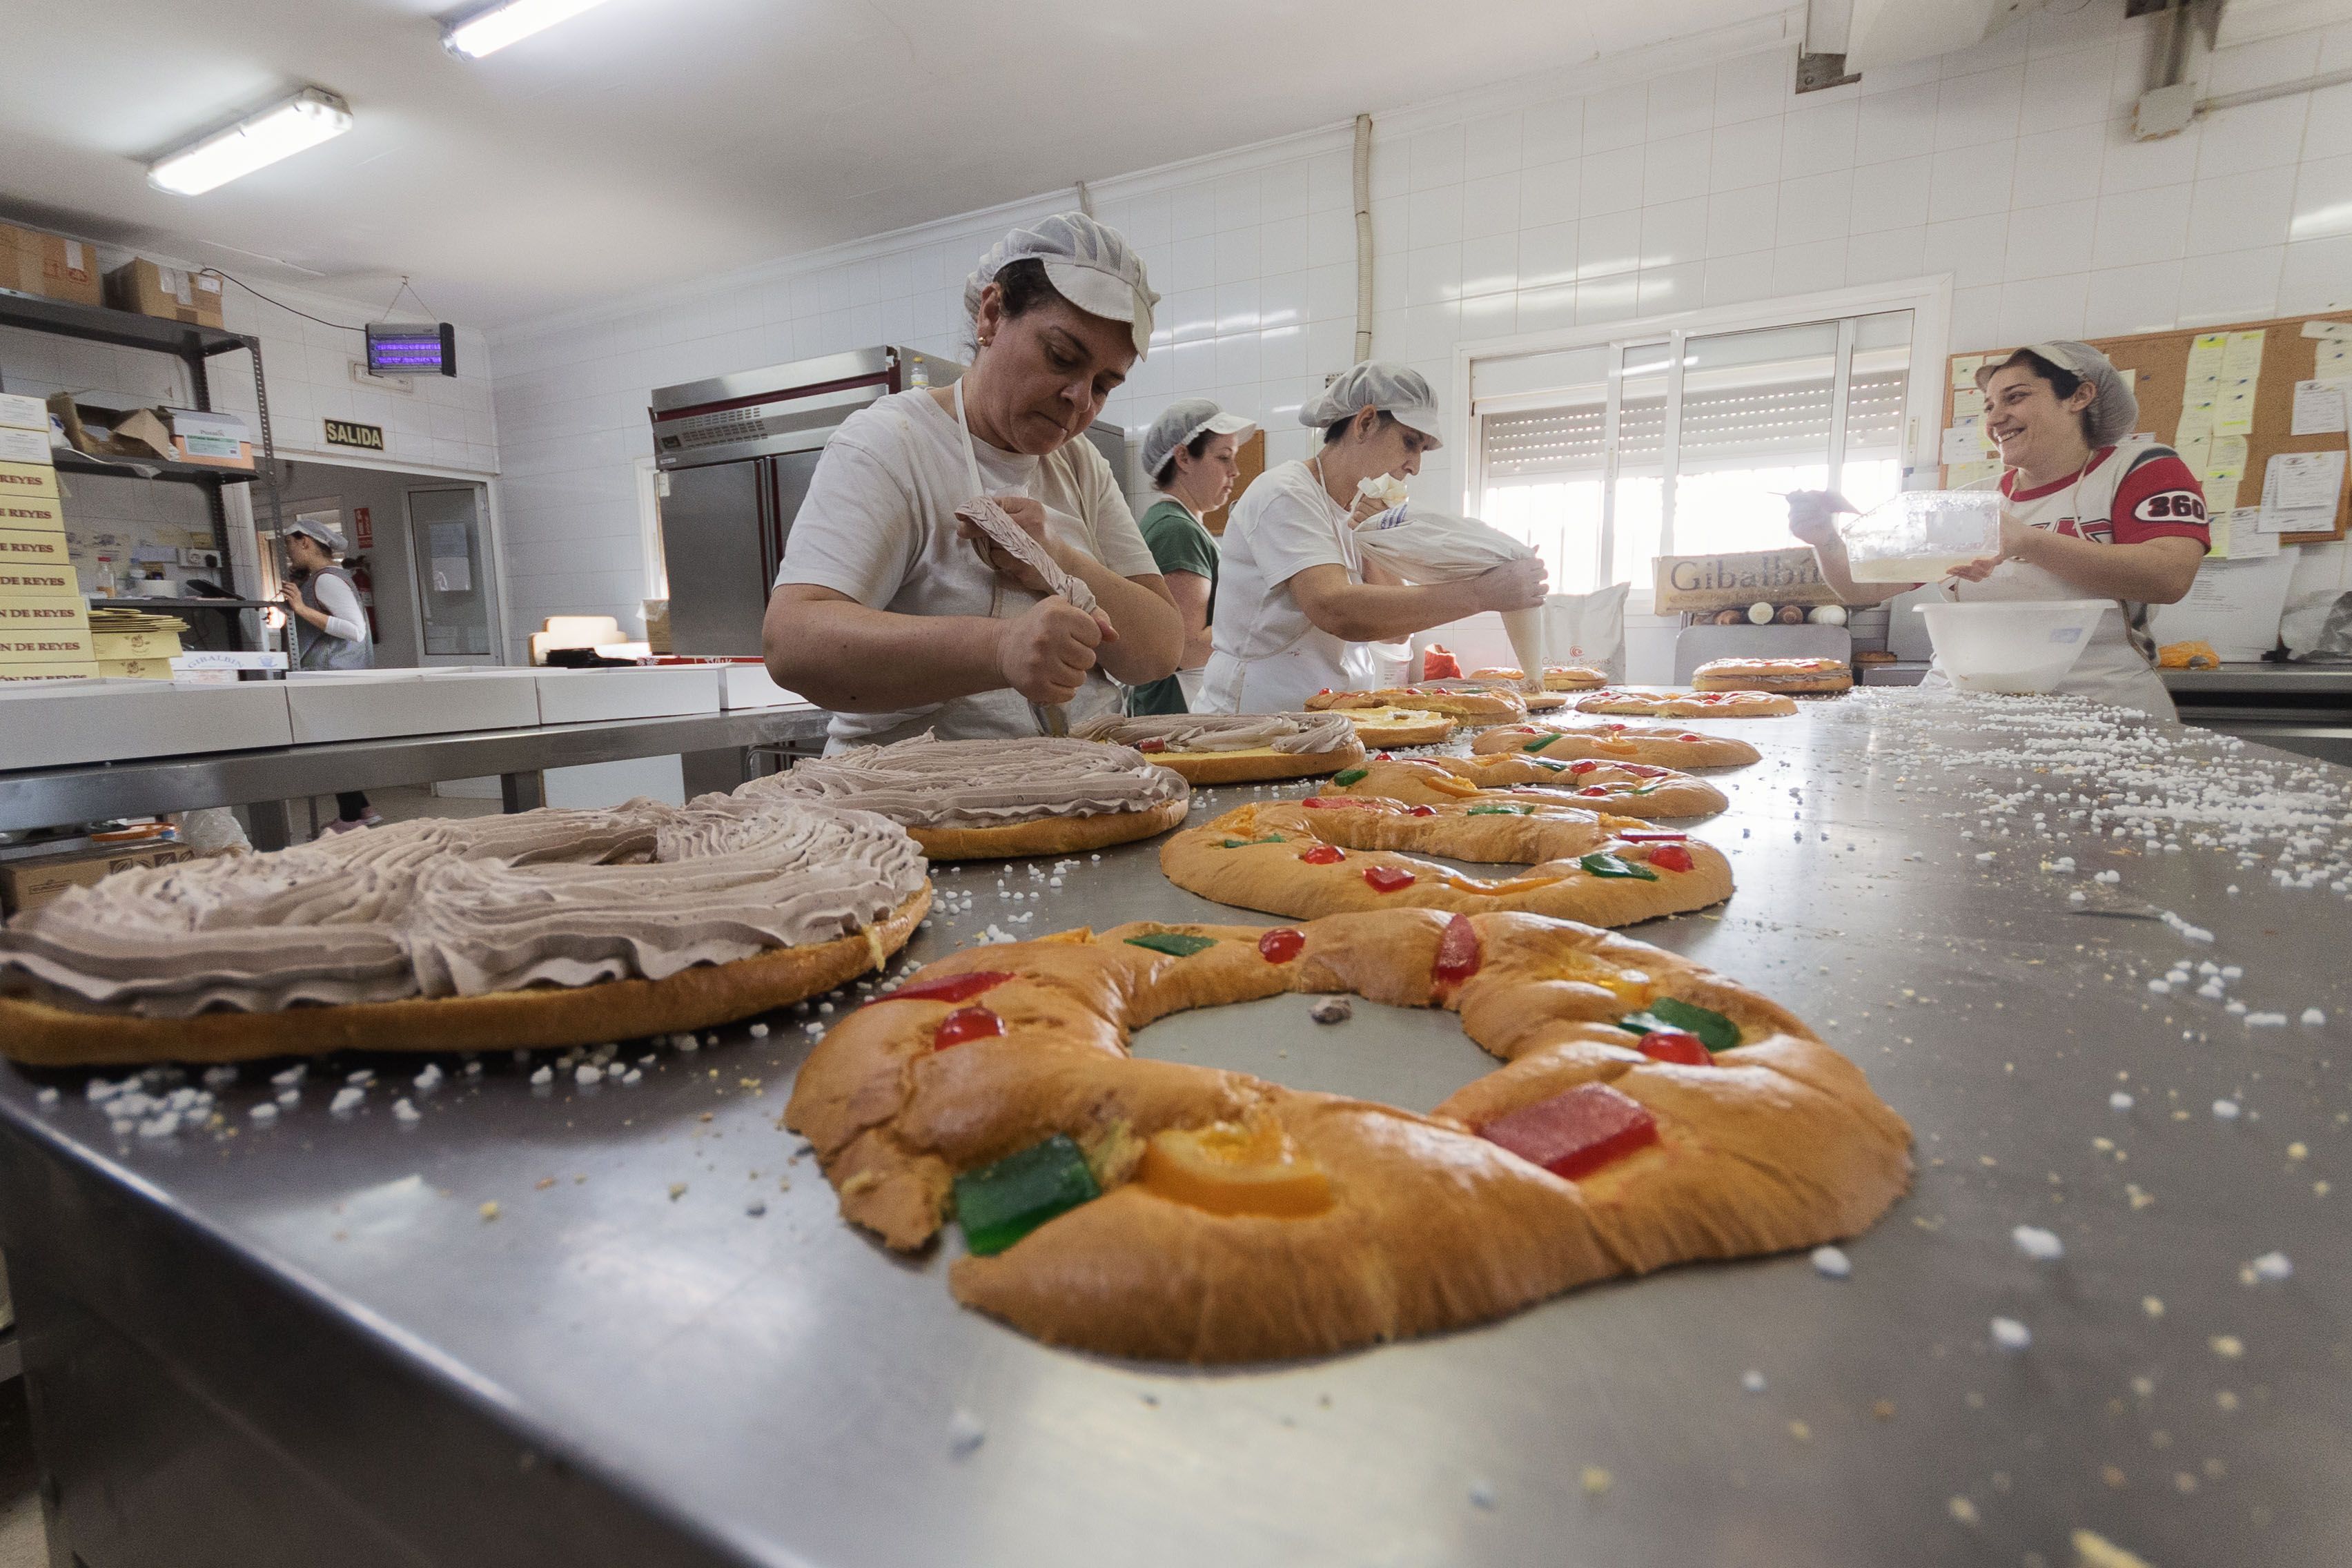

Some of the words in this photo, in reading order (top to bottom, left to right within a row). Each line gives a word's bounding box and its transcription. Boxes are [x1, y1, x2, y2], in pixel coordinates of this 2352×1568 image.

[327, 422, 382, 447] SALIDA
[0, 475, 43, 485] REYES
[2147, 495, 2205, 520] 360
[9, 509, 52, 519] REYES
[10, 543, 55, 553] REYES
[0, 576, 20, 585] DE
[22, 577, 66, 586] REYES
[10, 609, 30, 618] DE
[32, 609, 75, 618] REYES
[14, 643, 35, 651] DE
[37, 643, 80, 651] REYES
